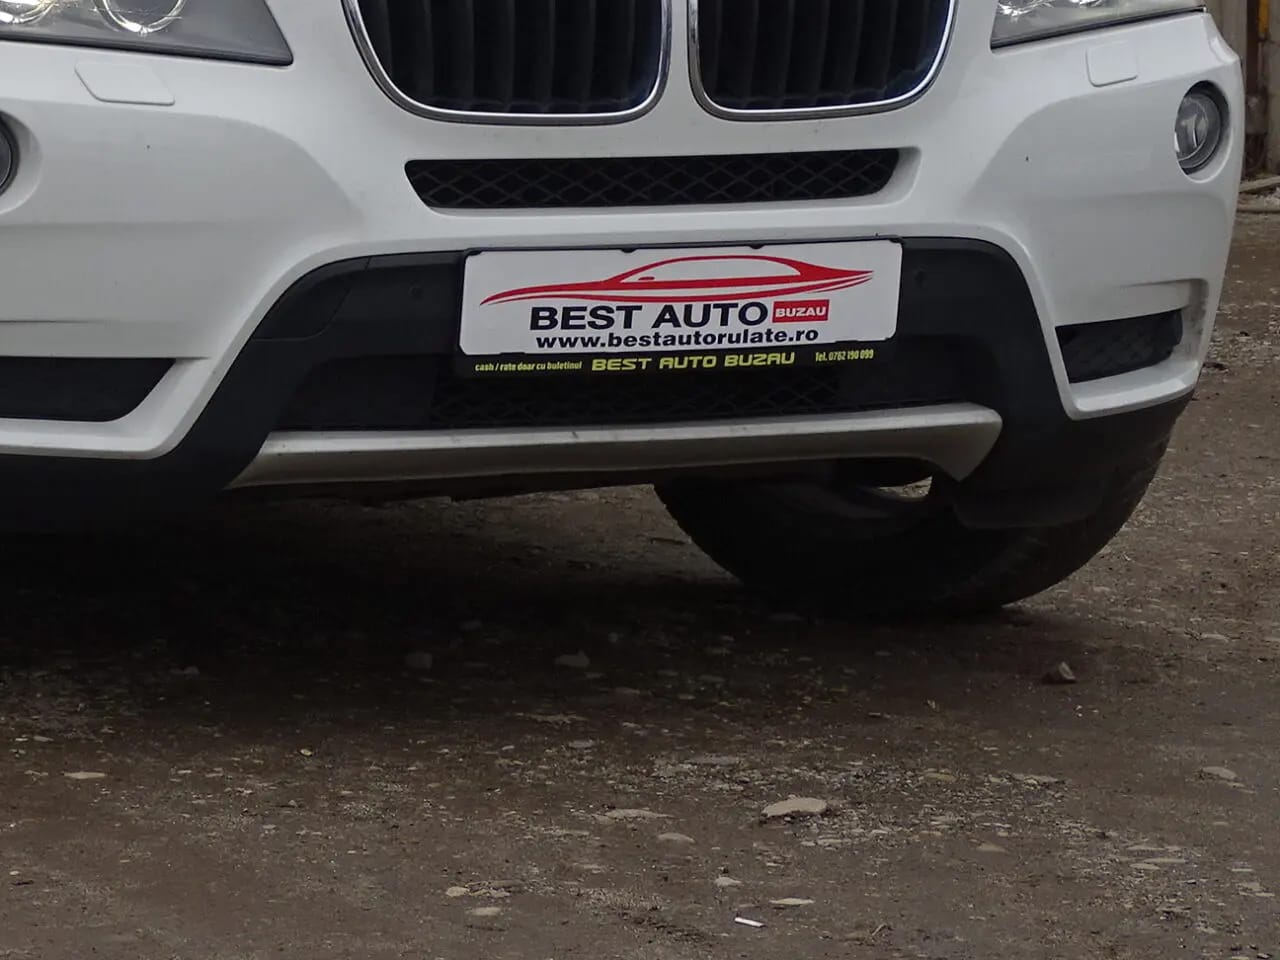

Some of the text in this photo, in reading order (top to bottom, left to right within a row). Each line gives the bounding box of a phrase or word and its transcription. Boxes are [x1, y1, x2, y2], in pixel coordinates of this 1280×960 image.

[530, 301, 827, 331] BEST AUTO BUZAU
[536, 328, 819, 349] www.bestautorulate.ro
[591, 357, 653, 372] BEST
[659, 355, 717, 369] AUTO
[724, 351, 795, 368] BUZAU
